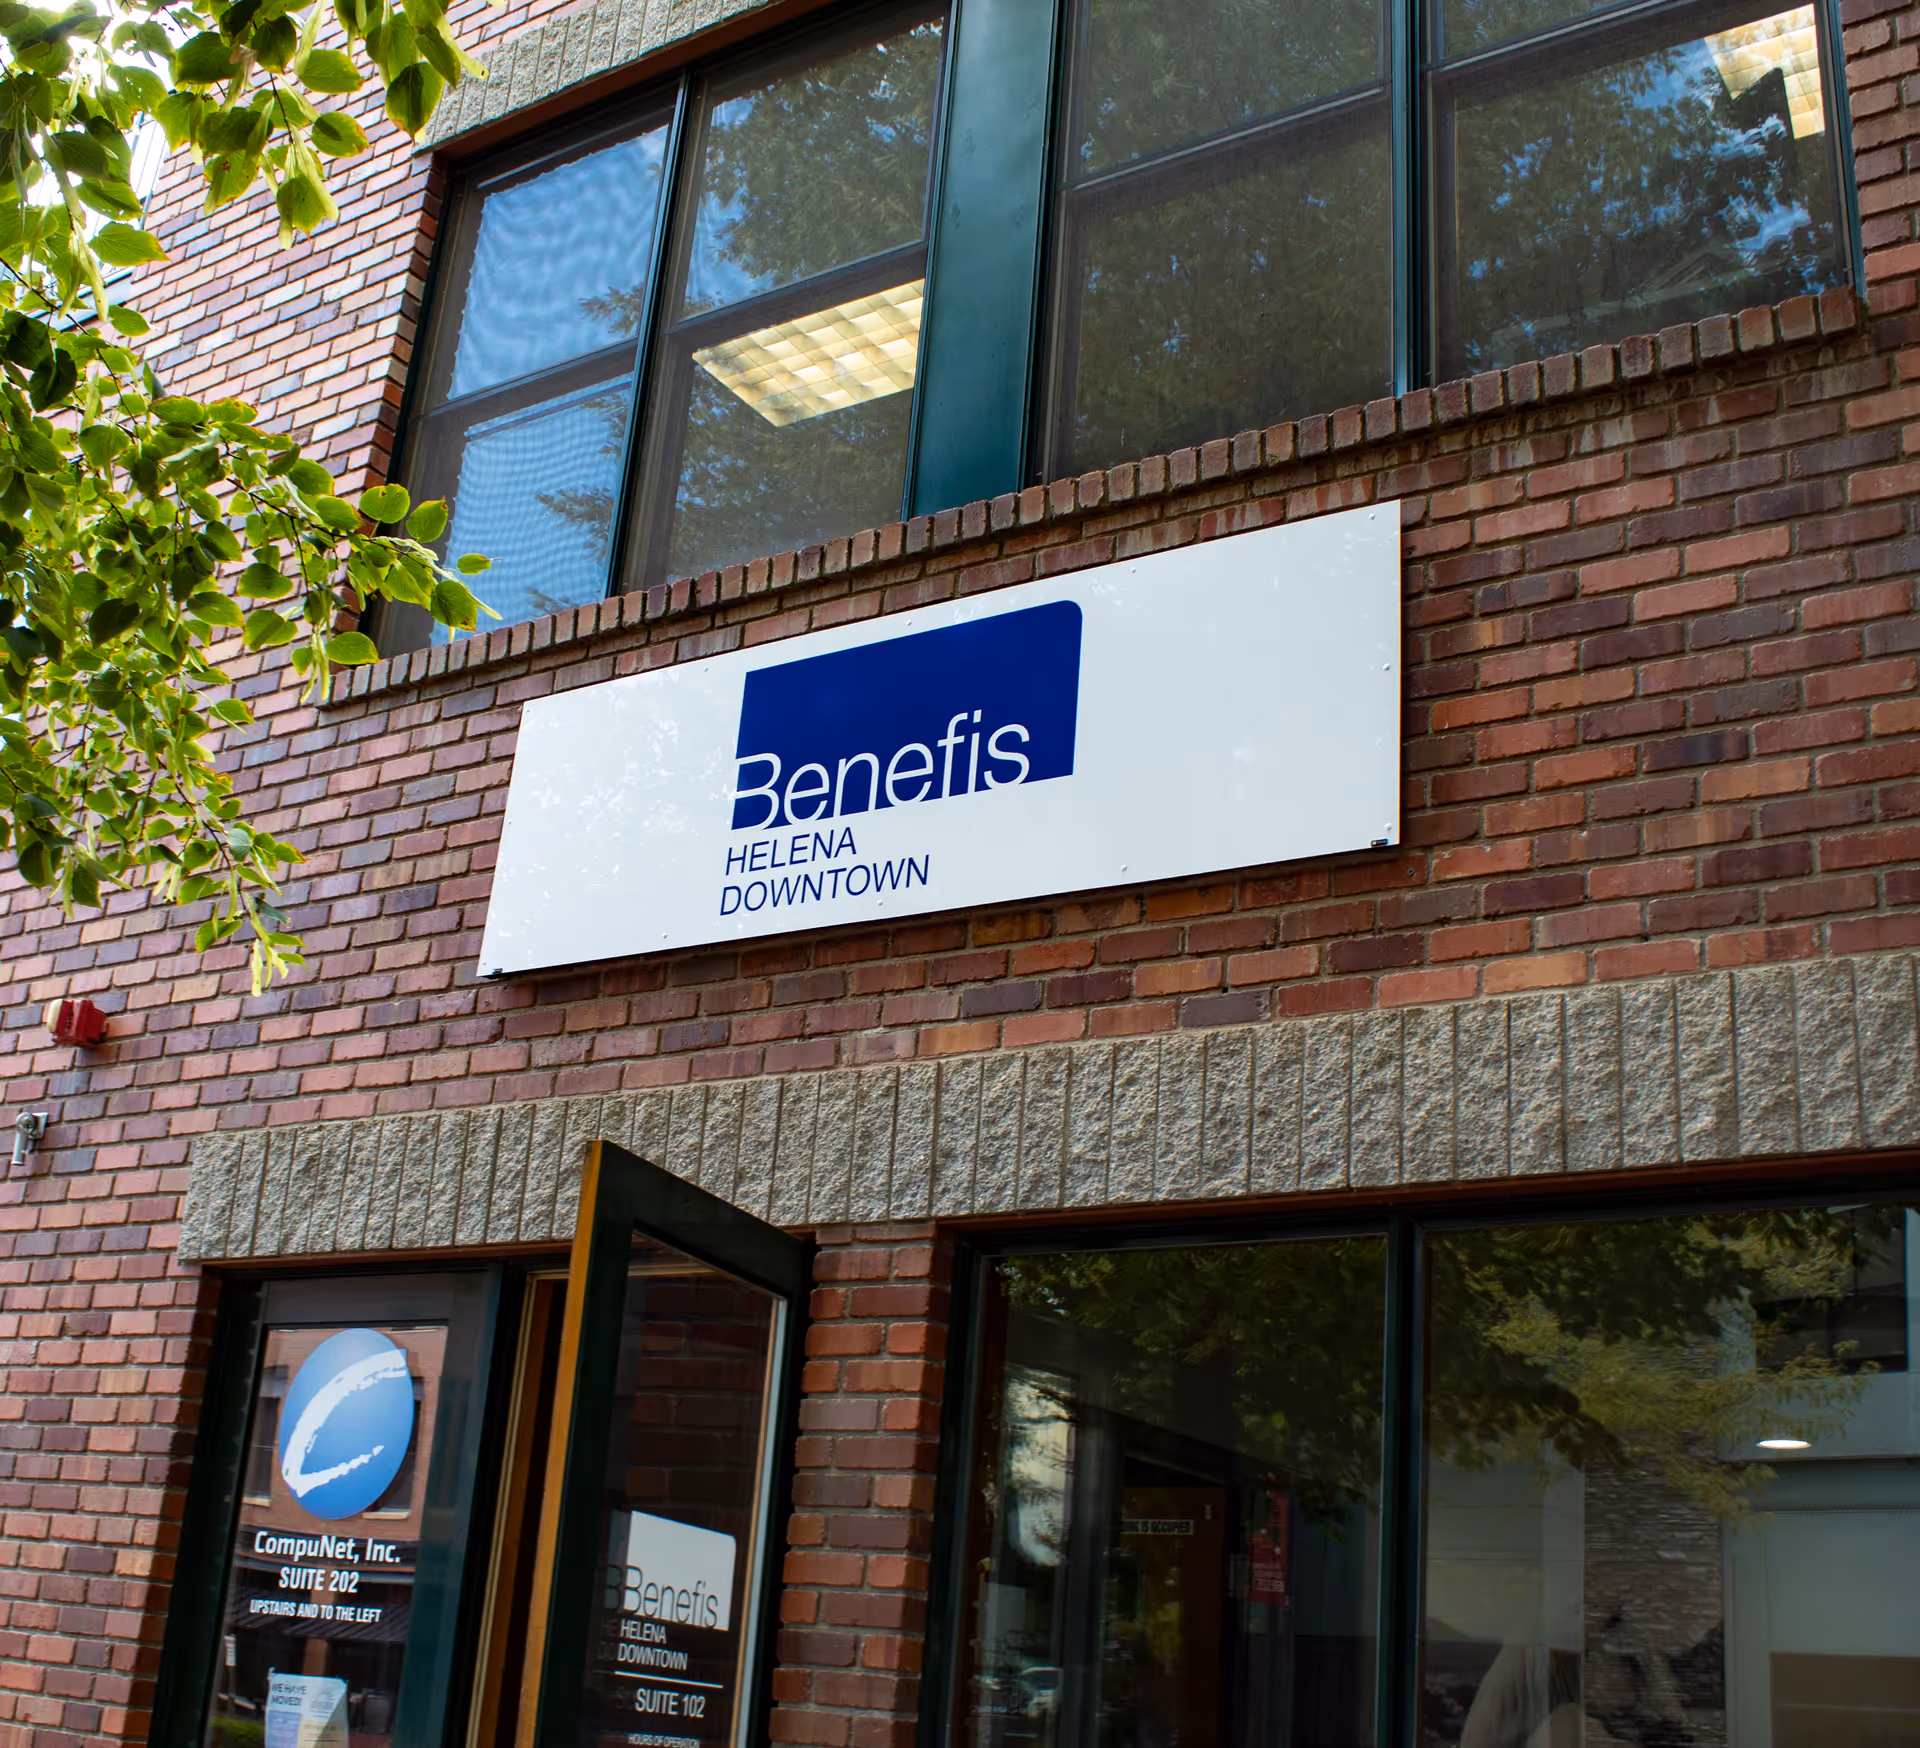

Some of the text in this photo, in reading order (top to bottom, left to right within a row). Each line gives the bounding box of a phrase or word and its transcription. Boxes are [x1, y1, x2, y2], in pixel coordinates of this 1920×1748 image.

[732, 709, 1031, 830] Benefis
[725, 827, 857, 875] HELENA
[720, 855, 930, 916] DOWNTOWN
[254, 1531, 401, 1564] CompuNet, Inc.
[278, 1566, 360, 1593] SUITE 202
[249, 1599, 382, 1623] UPSTAIRS AND TO THE LEFT
[623, 1564, 719, 1629] Benefis
[620, 1618, 667, 1644] HELENA
[617, 1643, 688, 1671] DOWNTOWN
[635, 1687, 706, 1718] SUITE 102
[628, 1733, 653, 1746] HOURS
[653, 1735, 664, 1747] OF
